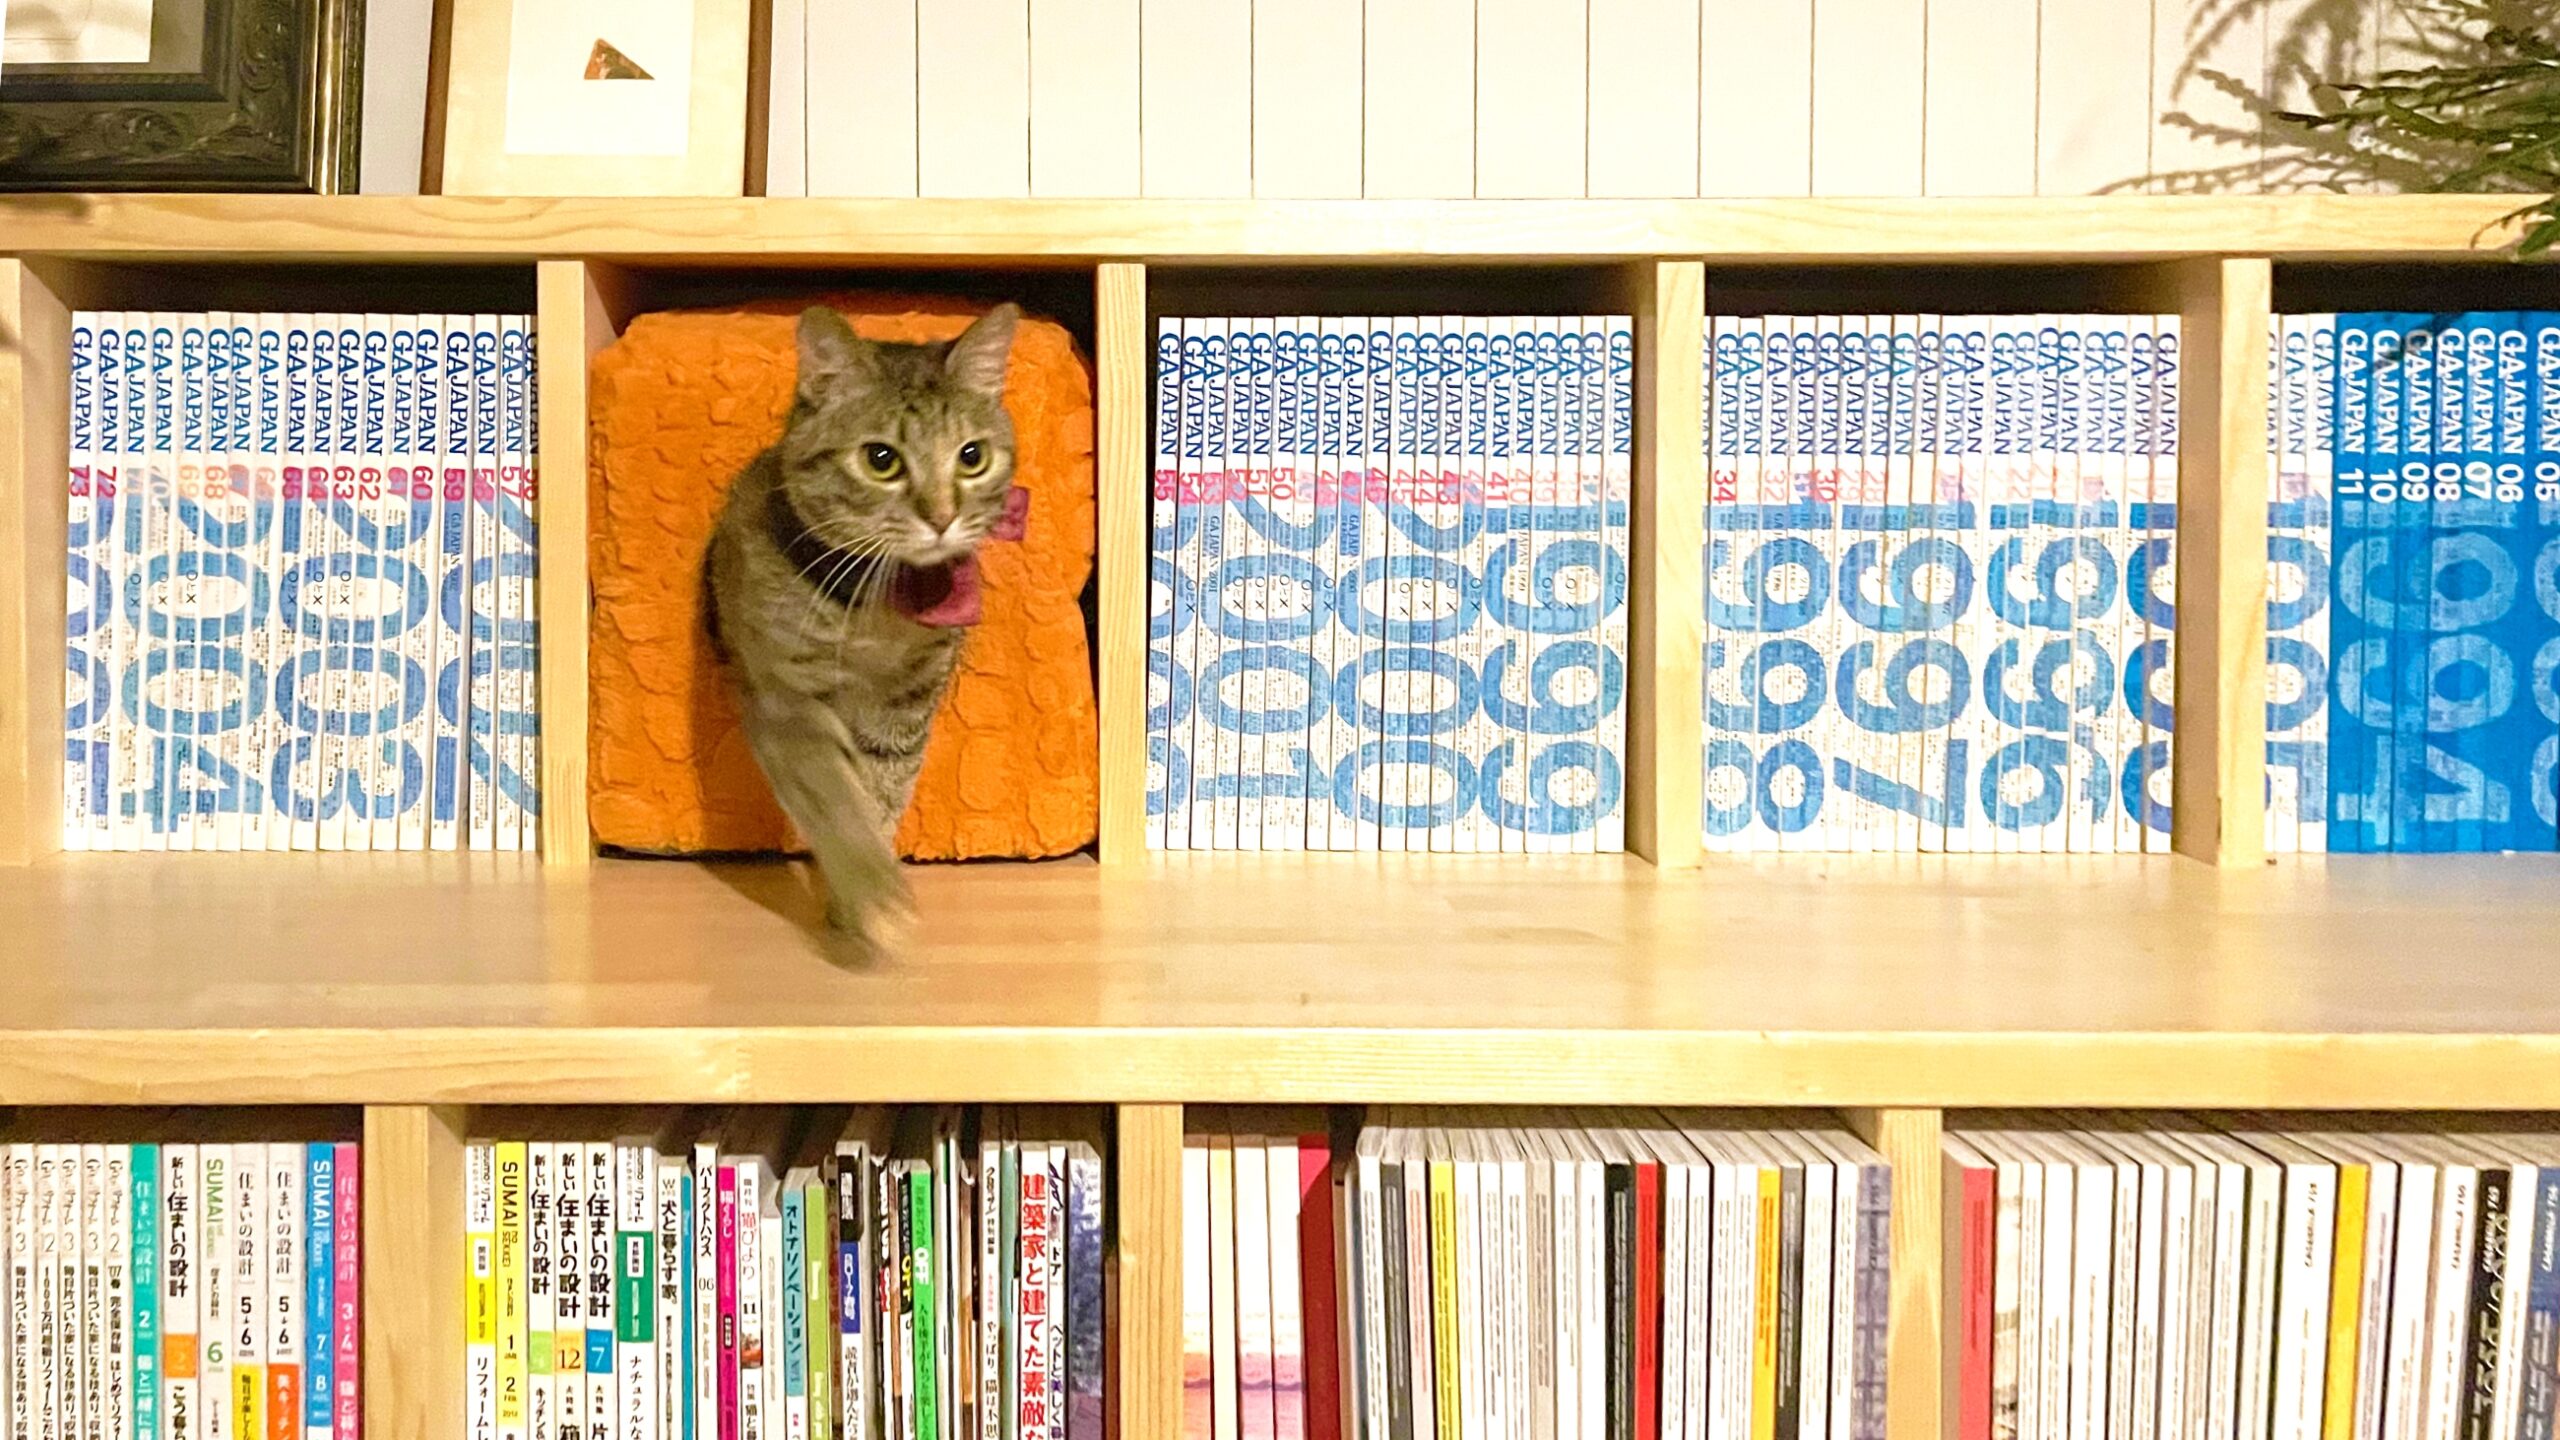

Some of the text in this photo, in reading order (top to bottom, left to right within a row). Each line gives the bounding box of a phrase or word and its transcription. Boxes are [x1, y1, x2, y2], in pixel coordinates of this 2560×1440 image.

[70, 466, 90, 496] 73
[96, 467, 116, 496] 72
[204, 466, 225, 498] 68
[282, 469, 302, 499] 65
[307, 467, 328, 500] 64
[333, 466, 355, 498] 63
[359, 468, 380, 500] 62
[411, 466, 432, 499] 60
[443, 468, 465, 499] 59
[499, 466, 521, 497] 57
[1154, 469, 1176, 500] 55
[1248, 469, 1268, 499] 51
[1271, 467, 1293, 499] 50
[1392, 471, 1414, 504] 45
[1415, 469, 1437, 504] 44
[1487, 471, 1507, 499] 41
[1712, 471, 1737, 503] 34
[2337, 467, 2364, 495] 11
[2369, 468, 2397, 503] 10
[2401, 463, 2430, 502] 09
[2433, 463, 2462, 502] 08
[2464, 462, 2493, 501] 07
[2496, 464, 2524, 503] 06
[2535, 463, 2560, 502] 05
[120, 465, 274, 833] 2004
[271, 465, 432, 821] 2003
[1197, 465, 1338, 802] 2001
[1333, 465, 1484, 829] 2000
[1480, 485, 1626, 836] 1999
[206, 1158, 224, 1223] SUMAI
[312, 1161, 331, 1228] SUMAI
[502, 1161, 518, 1227] SUMAI
[87, 1232, 99, 1252] 3
[109, 1232, 120, 1253] 2
[556, 1153, 581, 1318] 新しい住まいの設計
[586, 1152, 611, 1318] 新しい住まいの設計
[698, 1278, 715, 1291] 06
[138, 1309, 151, 1328] 2
[743, 1303, 757, 1315] 11
[207, 1341, 223, 1363] 6
[316, 1334, 327, 1351] 7
[506, 1334, 514, 1350] 1
[591, 1347, 605, 1368] 7
[560, 1349, 581, 1370] 12
[316, 1375, 327, 1391] 8
[506, 1377, 516, 1393] 2
